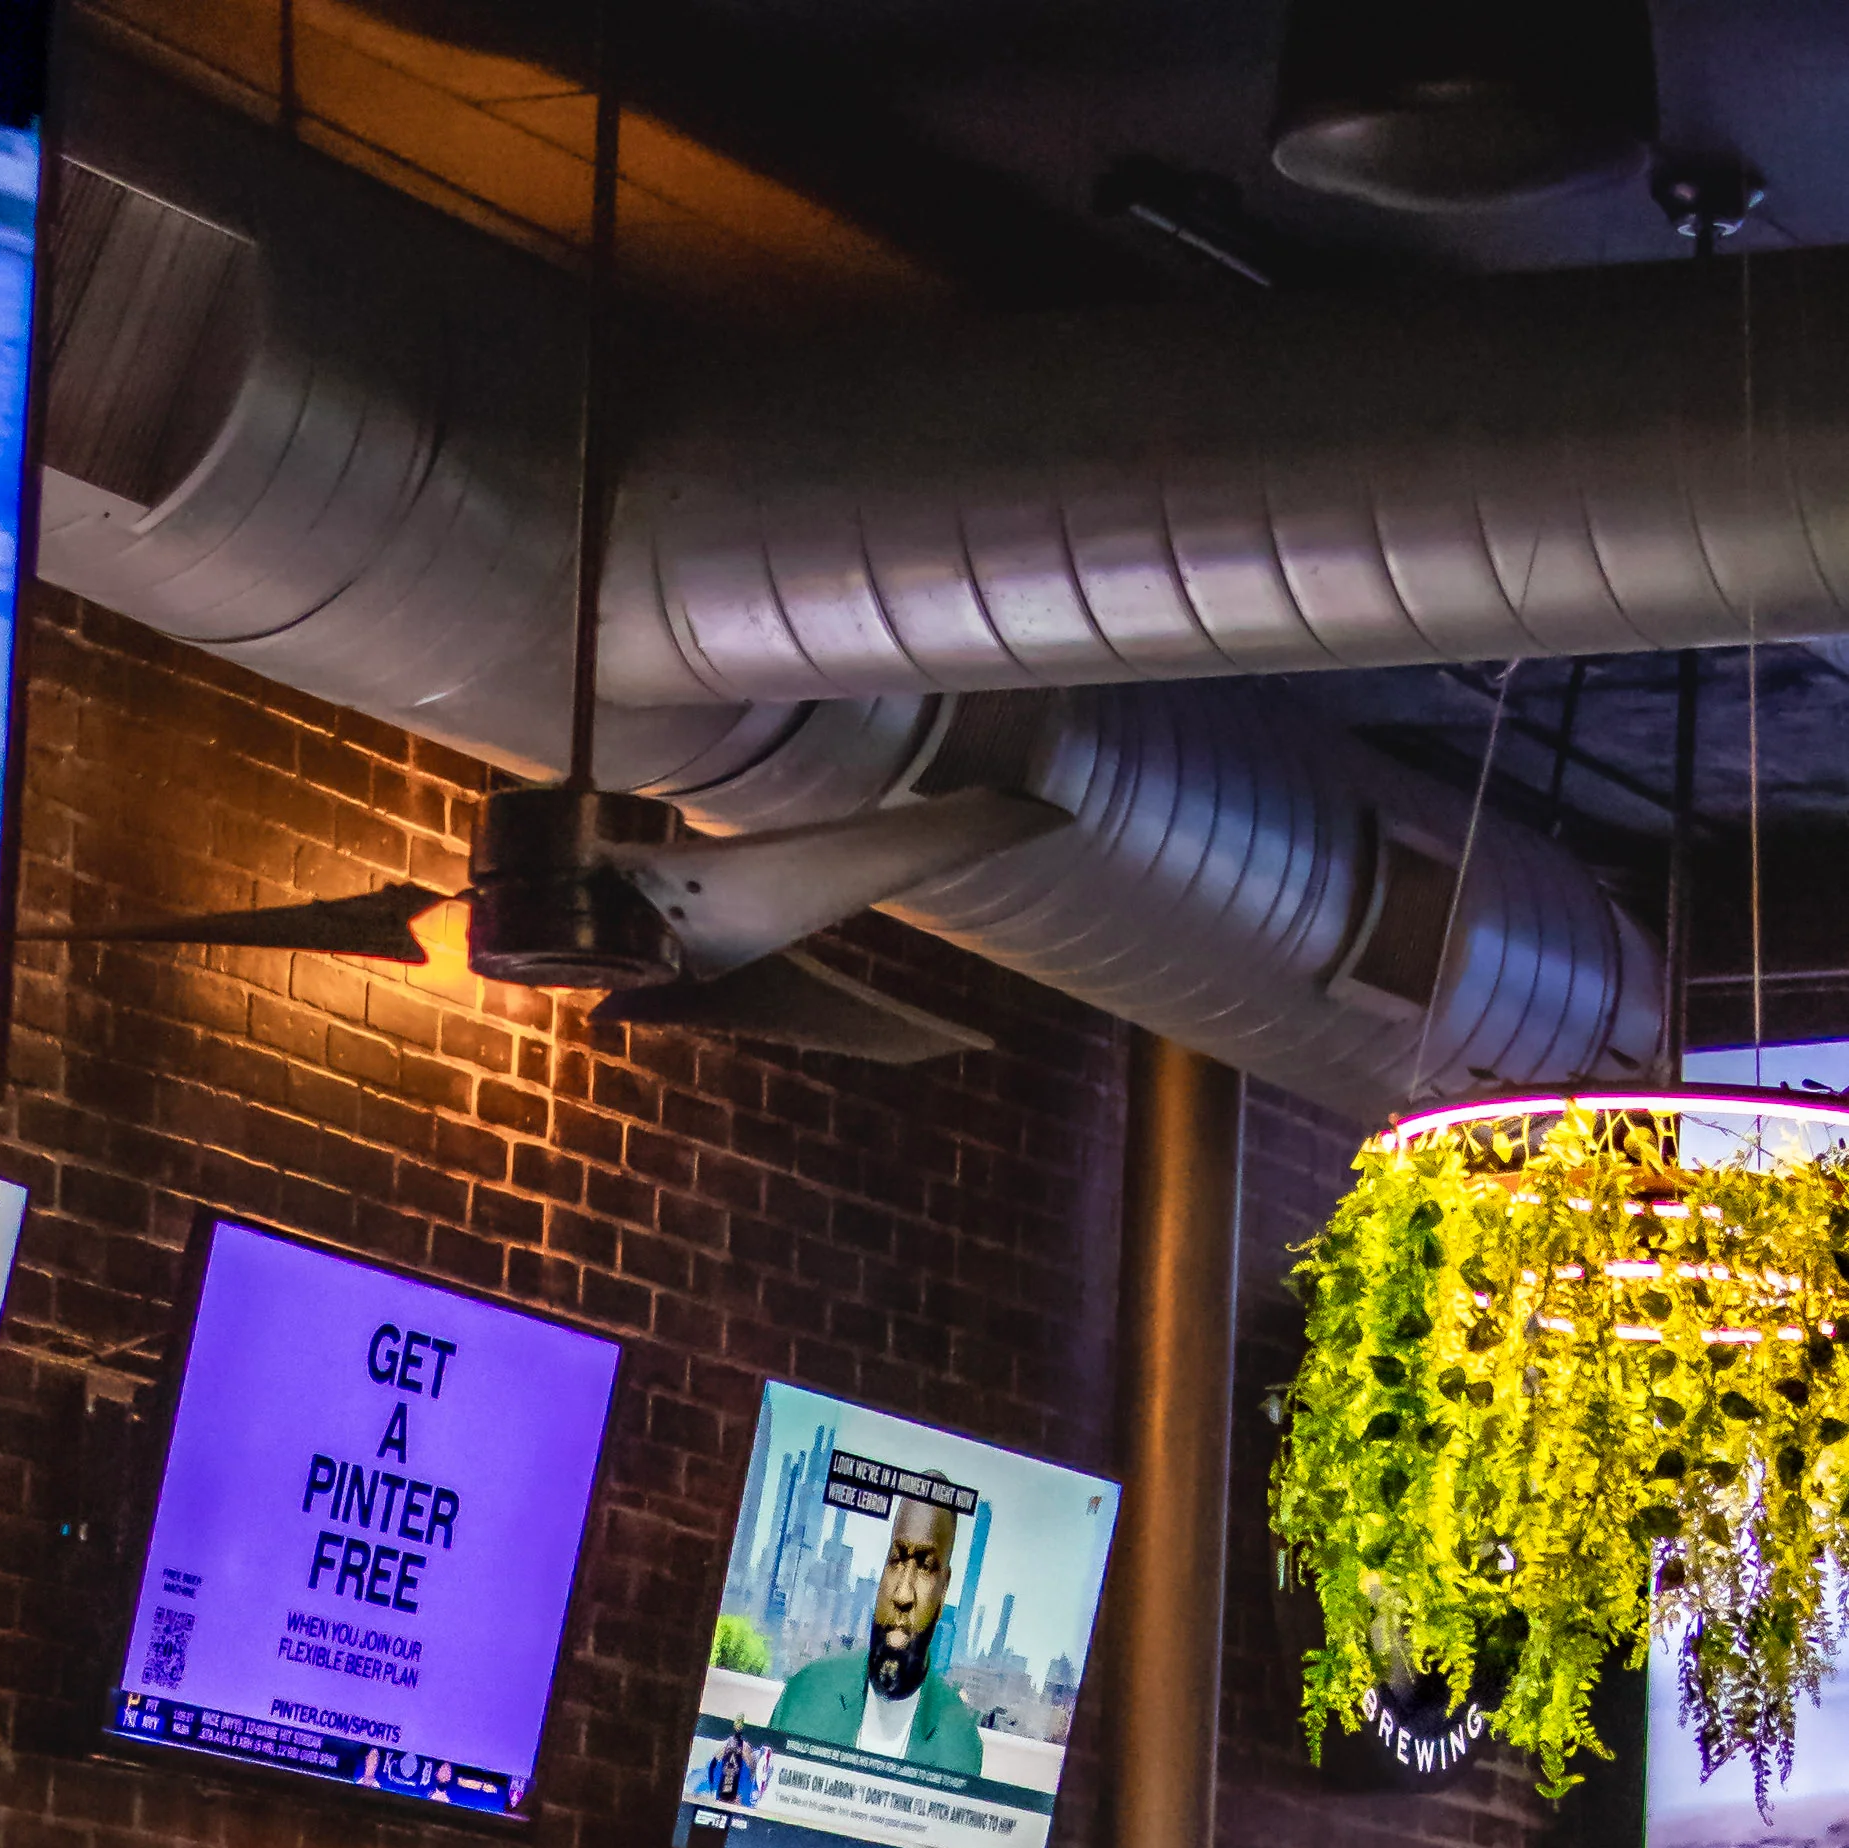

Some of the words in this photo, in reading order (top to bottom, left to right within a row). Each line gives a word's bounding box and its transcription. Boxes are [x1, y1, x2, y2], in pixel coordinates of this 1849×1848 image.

[367, 1322, 458, 1400] GET
[375, 1401, 408, 1464] A
[302, 1453, 460, 1550] PINTER
[307, 1530, 427, 1615] FREE
[278, 1636, 343, 1672] FLEXIBLE
[343, 1652, 382, 1681] BEER
[382, 1661, 420, 1689] PLAN
[287, 1611, 329, 1640] WHEN
[329, 1621, 359, 1647] YOU
[359, 1629, 390, 1655] JOIN
[392, 1636, 423, 1663] OUR
[270, 1698, 401, 1744] PINTER.COM/SPORTS
[1362, 1688, 1484, 1773] BREWING
